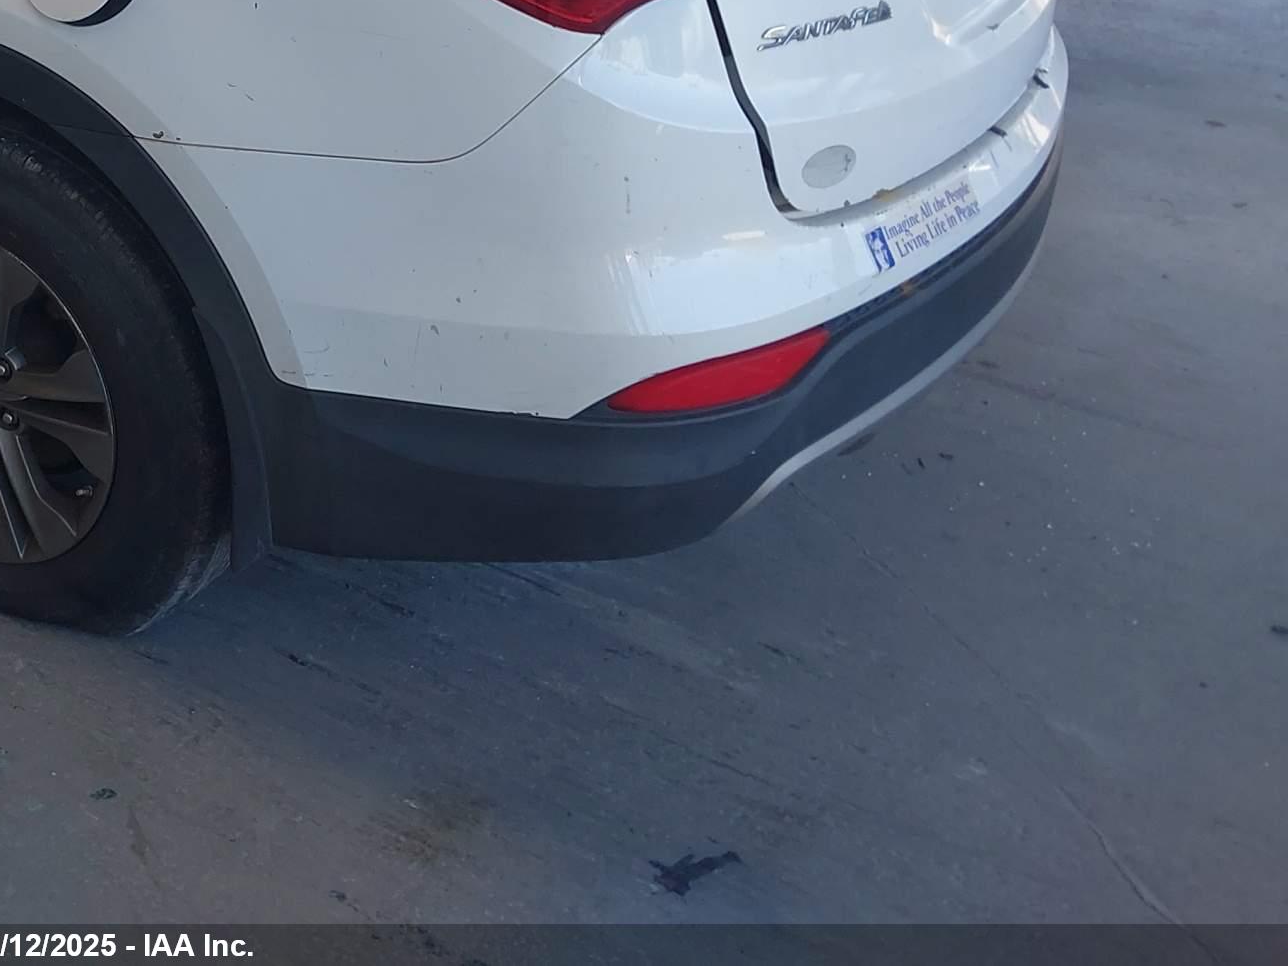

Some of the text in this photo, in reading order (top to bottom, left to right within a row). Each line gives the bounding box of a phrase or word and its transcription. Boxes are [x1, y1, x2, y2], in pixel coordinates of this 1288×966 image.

[883, 213, 920, 240] Imagine
[919, 200, 933, 220] All
[933, 196, 947, 213] the
[895, 230, 930, 258] Living
[925, 216, 948, 239] Life
[946, 212, 958, 228] in
